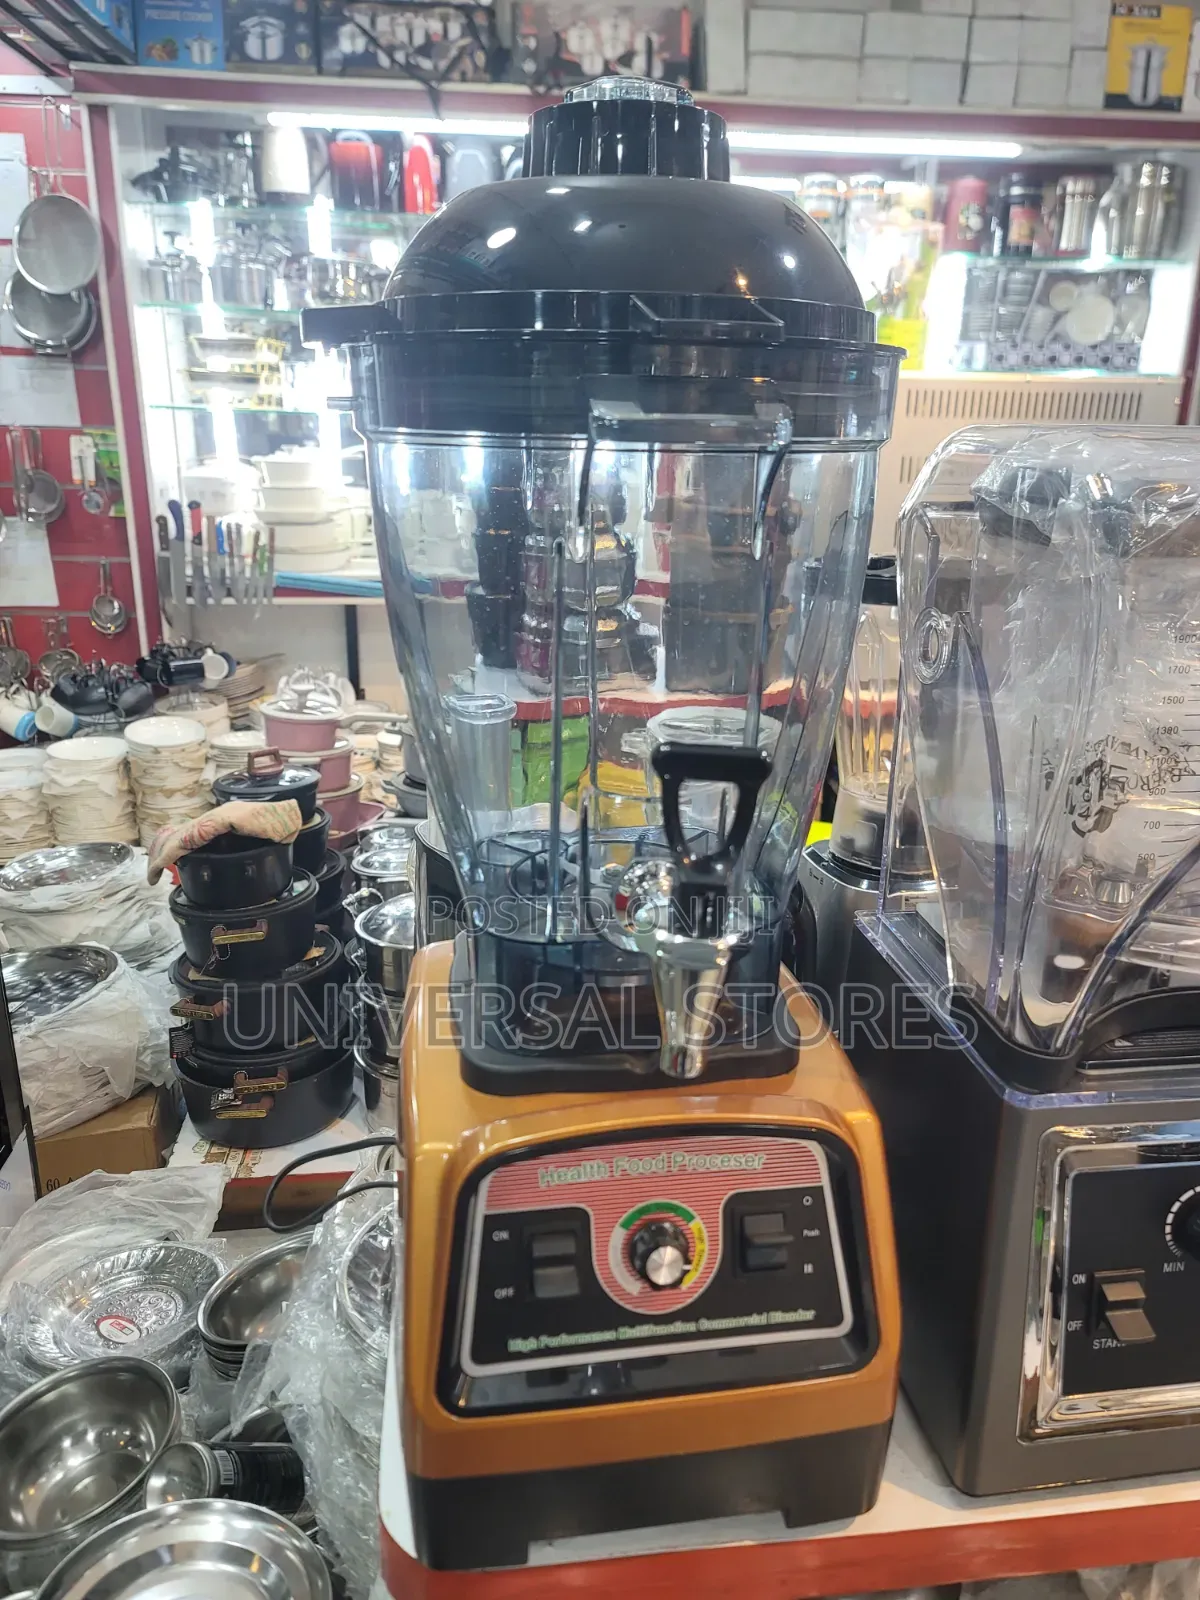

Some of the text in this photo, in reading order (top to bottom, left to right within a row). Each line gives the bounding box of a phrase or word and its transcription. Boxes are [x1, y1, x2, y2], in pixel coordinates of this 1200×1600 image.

[1168, 665, 1191, 675] 1700
[1161, 695, 1185, 705] 1500
[1143, 820, 1161, 830] 700
[1137, 852, 1156, 861] 500
[538, 1151, 767, 1188] Health Food Proceser
[46, 1177, 61, 1192] 60
[492, 1230, 510, 1242] ON
[1162, 1261, 1186, 1273] MIN
[1072, 1273, 1087, 1285] ON
[494, 1287, 515, 1300] OFF
[507, 1336, 538, 1353] High
[768, 1308, 816, 1324] Blender
[1067, 1320, 1083, 1332] OFF
